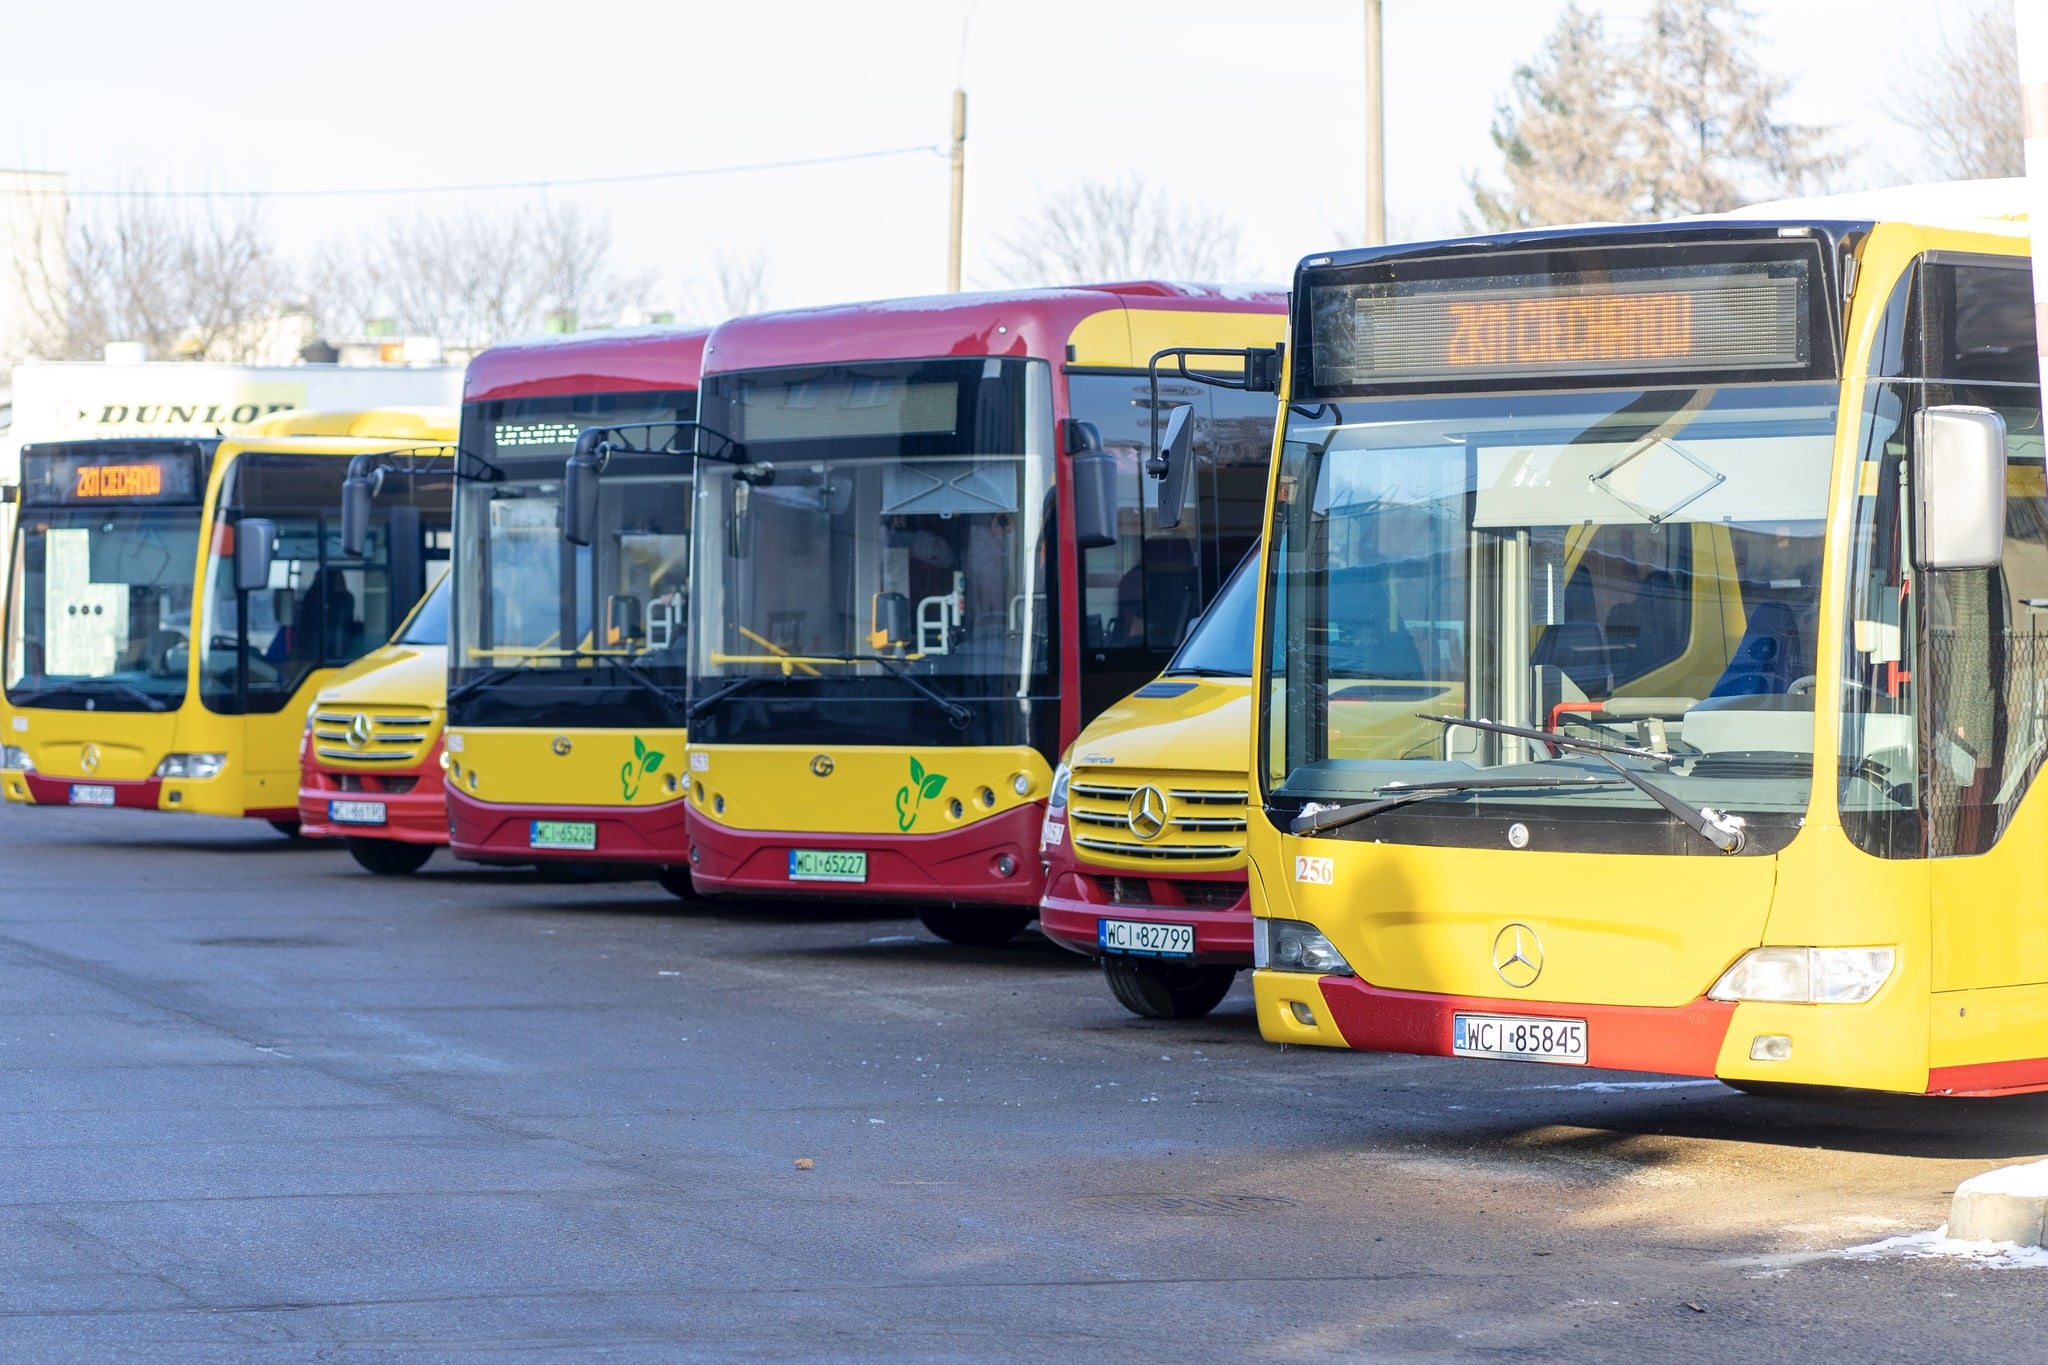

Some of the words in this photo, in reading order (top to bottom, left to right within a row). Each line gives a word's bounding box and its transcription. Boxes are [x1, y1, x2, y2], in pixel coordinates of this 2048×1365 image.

[797, 855, 817, 872] WCI
[824, 856, 863, 873] 65227
[1298, 857, 1331, 883] 256
[1108, 923, 1132, 946] WCI
[1140, 926, 1190, 950] 82799
[1468, 1022, 1502, 1050] WCI
[1516, 1025, 1581, 1053] 85845
